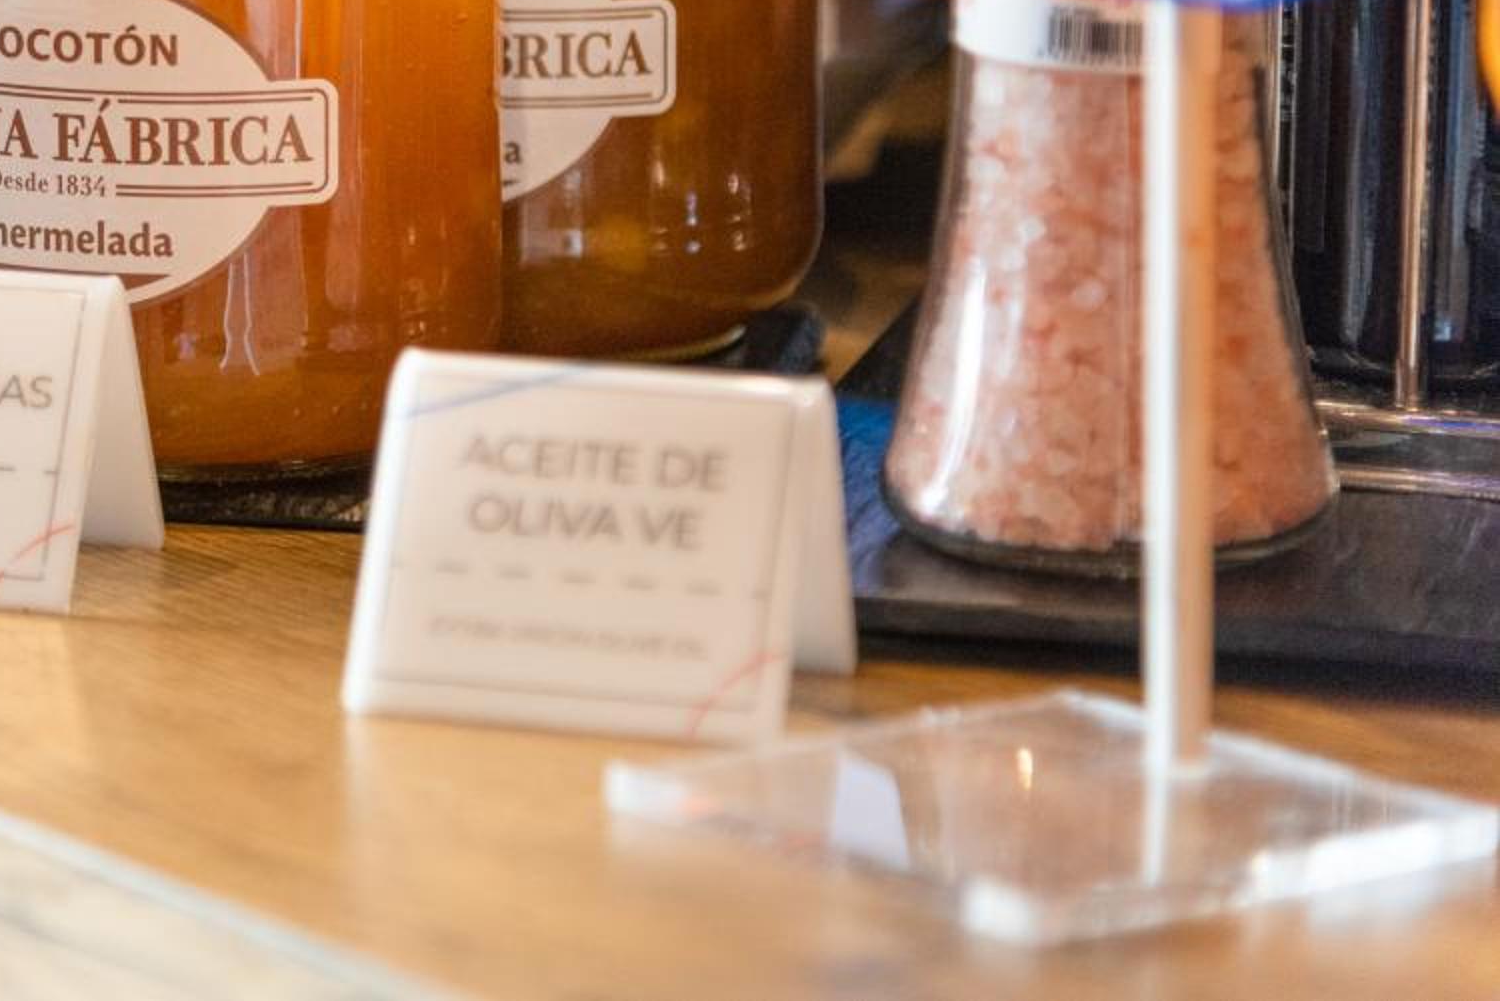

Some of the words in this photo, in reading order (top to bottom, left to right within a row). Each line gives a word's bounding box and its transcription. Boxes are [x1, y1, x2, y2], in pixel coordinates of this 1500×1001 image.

[52, 99, 313, 167] FÁBRICA
[54, 174, 107, 198] 1834
[463, 434, 641, 486] ACEITE
[657, 445, 728, 492] DE
[467, 495, 623, 542] OLIVA
[638, 505, 703, 551] VE
